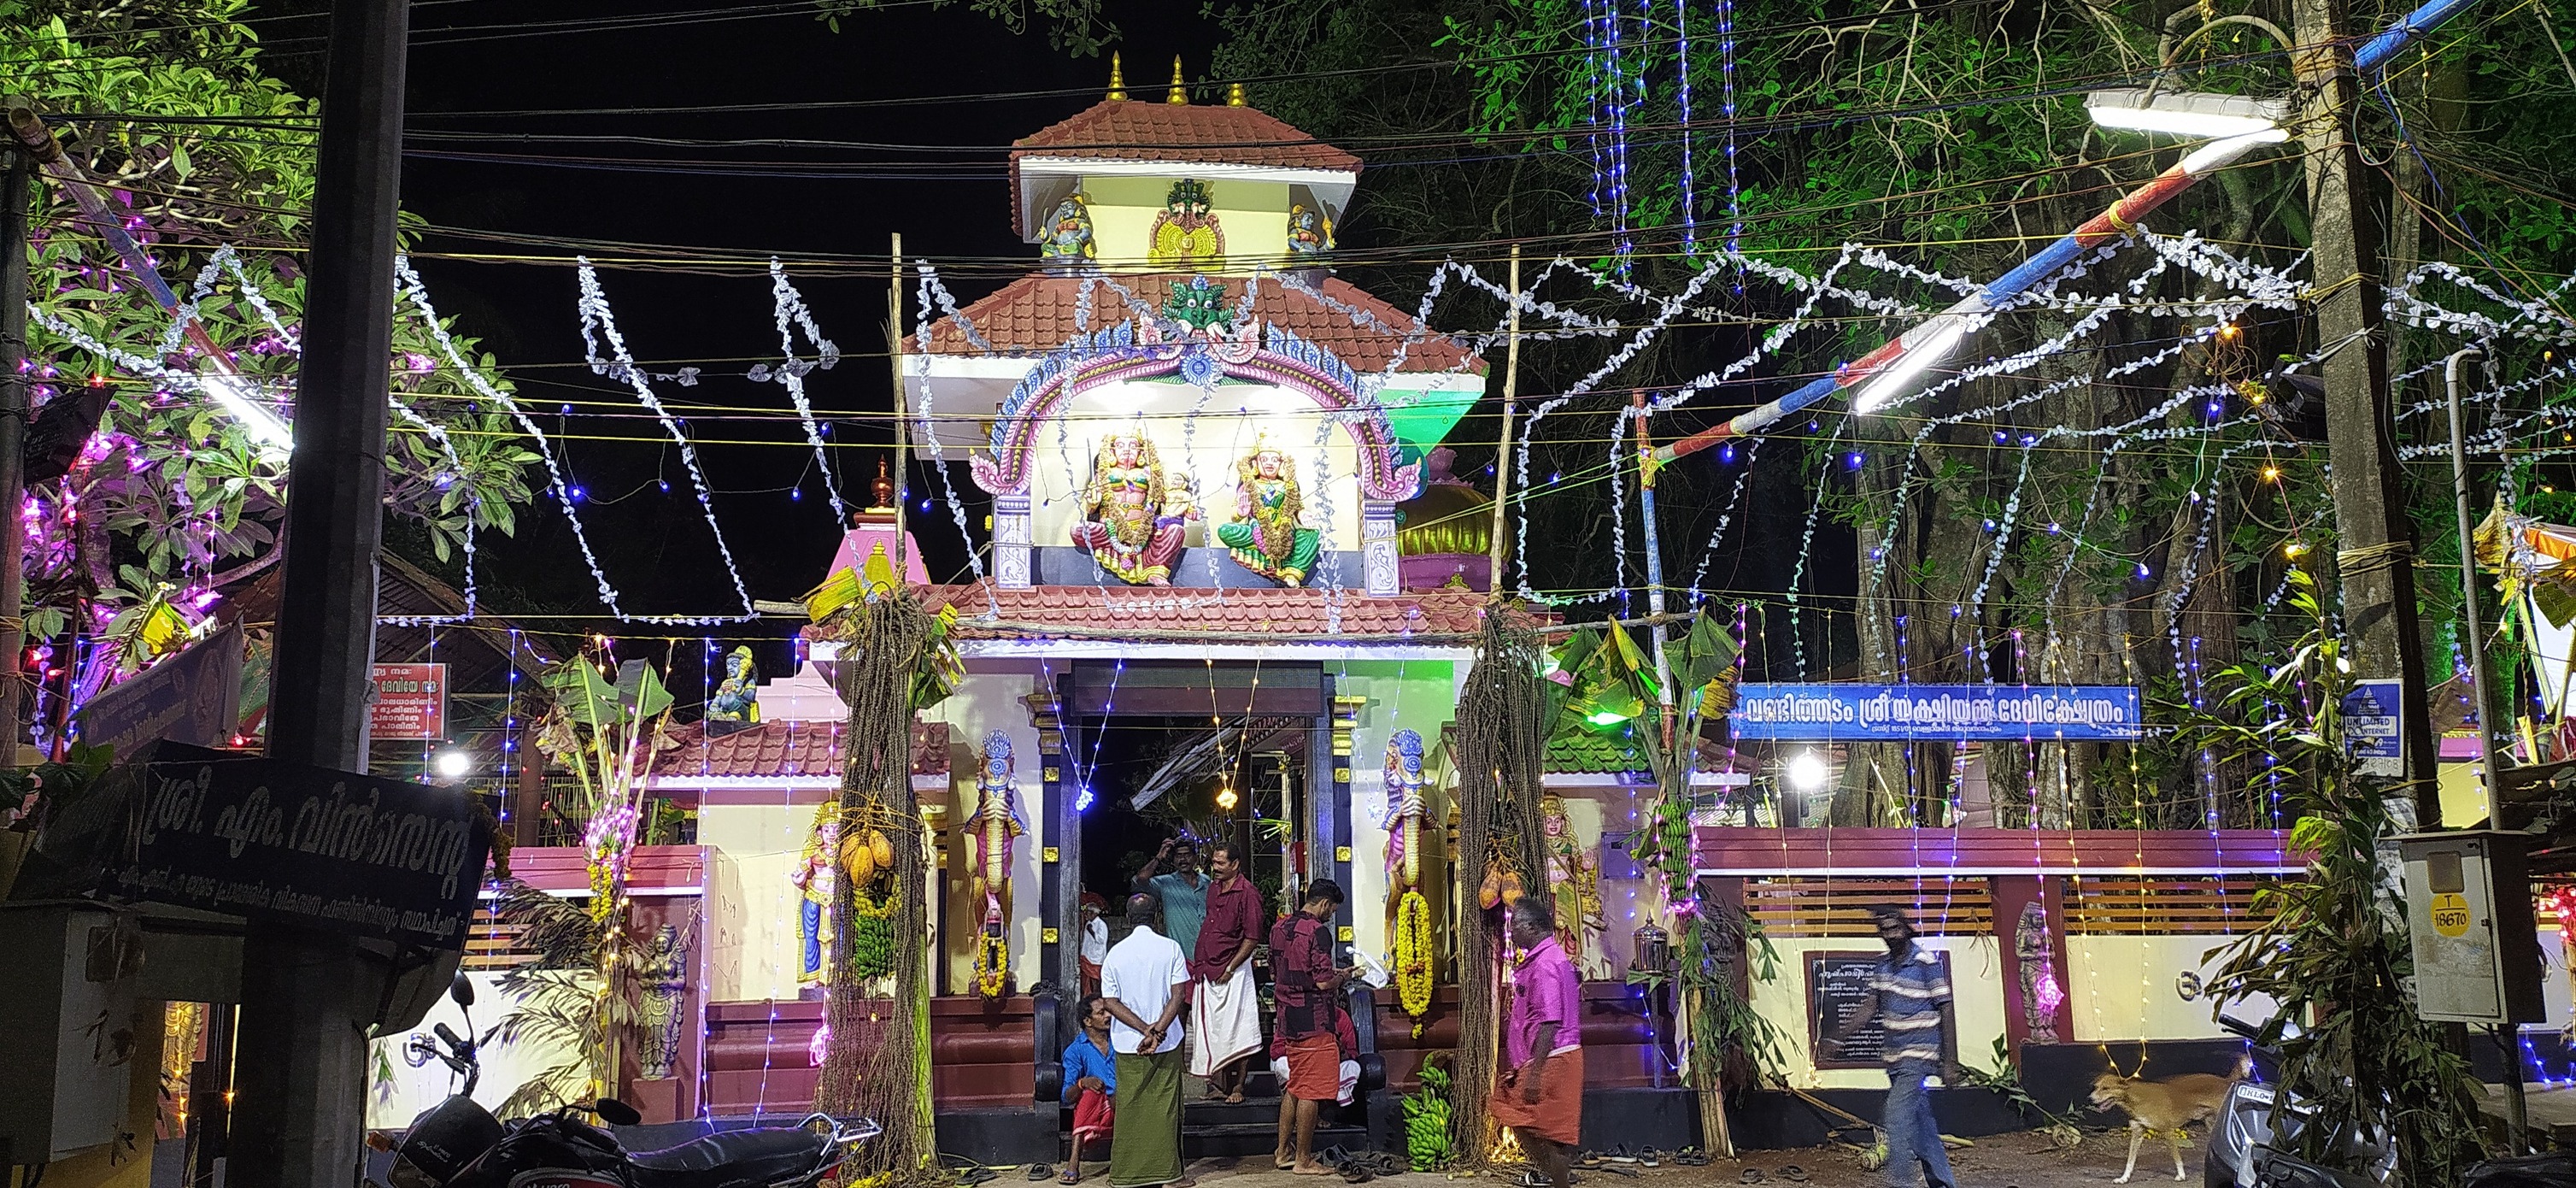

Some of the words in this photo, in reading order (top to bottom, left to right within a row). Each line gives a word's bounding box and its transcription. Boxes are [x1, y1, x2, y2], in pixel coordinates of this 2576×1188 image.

[1746, 691, 1854, 723] വണ്ടിത്തടം
[2346, 717, 2391, 726] UNLIMITED
[2444, 895, 2453, 908] T
[2435, 911, 2467, 927] 18670
